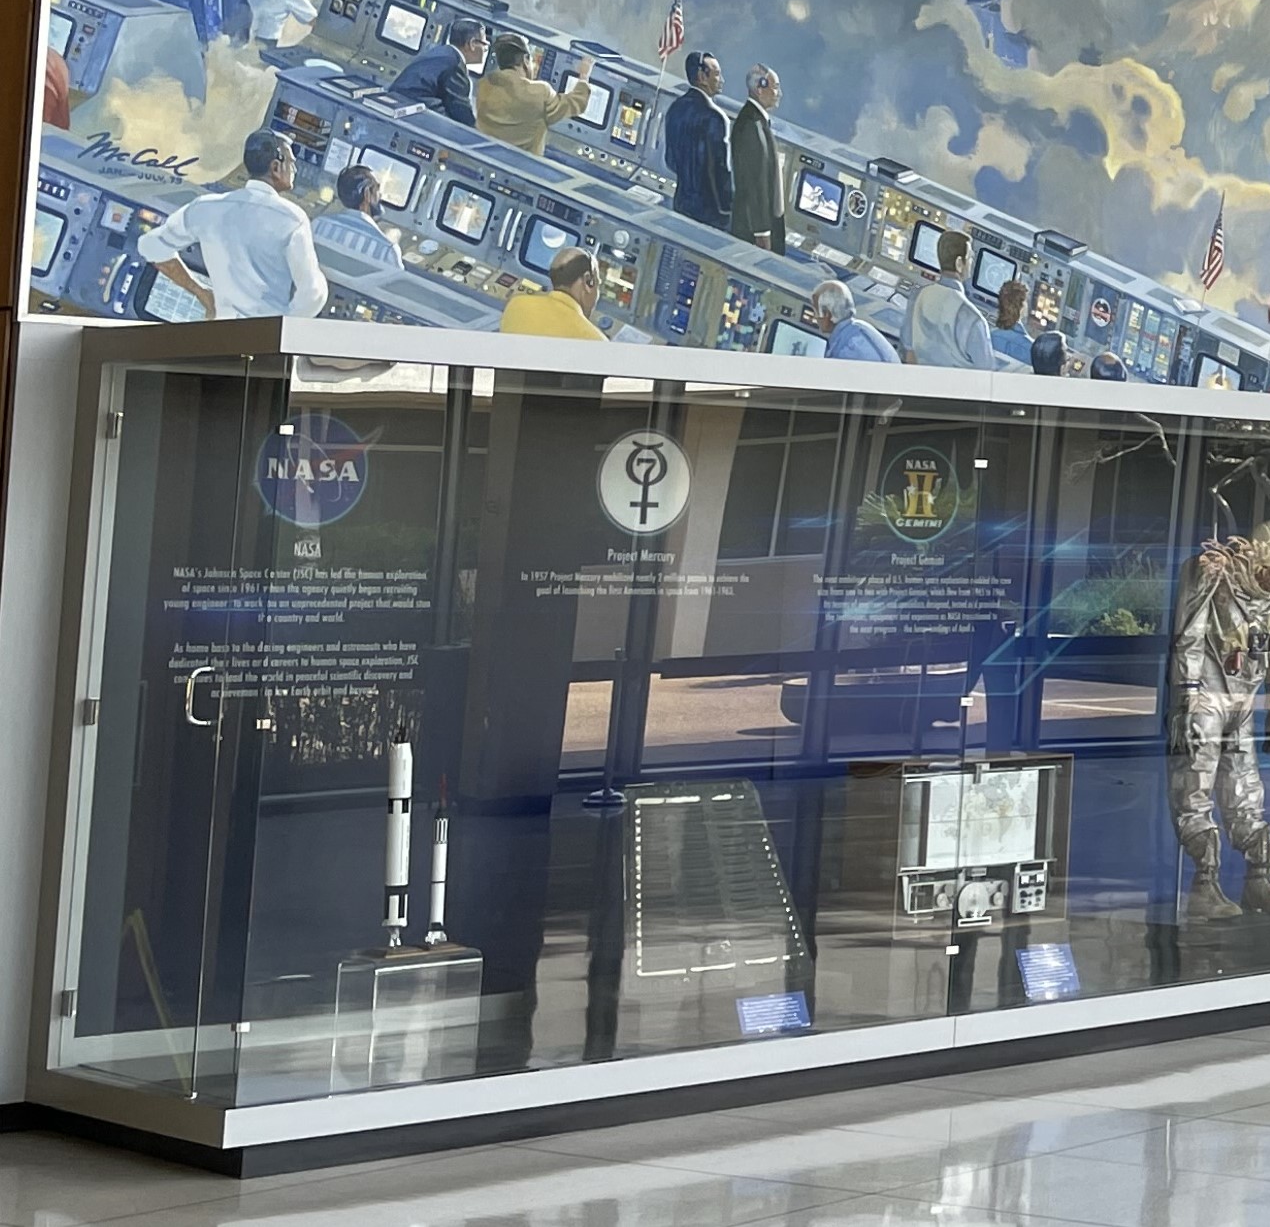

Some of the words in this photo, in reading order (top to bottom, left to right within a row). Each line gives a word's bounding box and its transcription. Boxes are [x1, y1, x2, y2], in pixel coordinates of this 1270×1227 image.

[267, 457, 359, 482] NASA
[906, 459, 937, 471] NASA
[895, 517, 942, 528] GEMINI
[294, 542, 322, 558] NASA
[607, 548, 638, 565] Project
[640, 549, 676, 565] Mercury
[891, 553, 916, 568] Project
[919, 554, 945, 565] Gemini
[173, 567, 202, 578] NASA's
[239, 567, 261, 580] Space
[292, 567, 313, 581] (JSC)
[314, 568, 328, 579] has
[330, 567, 342, 579] led
[344, 568, 356, 579] the
[358, 568, 384, 579] human
[386, 569, 427, 581] exploration
[521, 571, 528, 581] In
[550, 571, 573, 583] Project
[181, 582, 190, 592] of
[192, 585, 215, 595] space
[240, 582, 260, 593] 1961
[287, 582, 299, 593] the
[302, 586, 328, 595] agency
[331, 583, 357, 595] quietly
[358, 583, 381, 596] began
[383, 584, 418, 596] recruiting
[536, 584, 552, 597] goal
[553, 584, 560, 594] of
[562, 584, 594, 597] launching
[596, 585, 607, 595] the
[609, 584, 623, 594] first
[164, 600, 190, 612] young
[233, 599, 241, 607] to
[244, 597, 263, 607] work
[278, 599, 290, 608] an
[292, 598, 347, 610] unprecedented
[349, 599, 374, 610] project
[376, 597, 391, 608] that
[392, 598, 414, 608] would
[274, 614, 303, 625] country
[305, 611, 320, 622] and
[322, 611, 345, 622] world.
[174, 642, 183, 653] As
[186, 641, 209, 653] home
[232, 643, 240, 652] to
[242, 642, 255, 652] the
[257, 641, 285, 654] daring
[286, 644, 324, 654] engineers
[326, 640, 340, 651] and
[342, 642, 381, 651] astronauts
[382, 640, 397, 651] who
[399, 640, 416, 651] have
[168, 656, 208, 668] dedicated
[231, 656, 250, 667] lives
[270, 659, 298, 667] careers
[301, 658, 309, 666] to
[311, 655, 337, 666] human
[339, 658, 359, 668] space
[406, 654, 419, 665] JSC
[245, 672, 258, 682] the
[262, 671, 284, 681] world
[285, 672, 294, 681] in
[295, 670, 328, 684] peaceful
[330, 670, 361, 680] scientific
[364, 668, 397, 681] discovery
[398, 668, 413, 679] and
[291, 685, 311, 696] Earth
[313, 684, 331, 696] orbit
[333, 683, 348, 695] and
